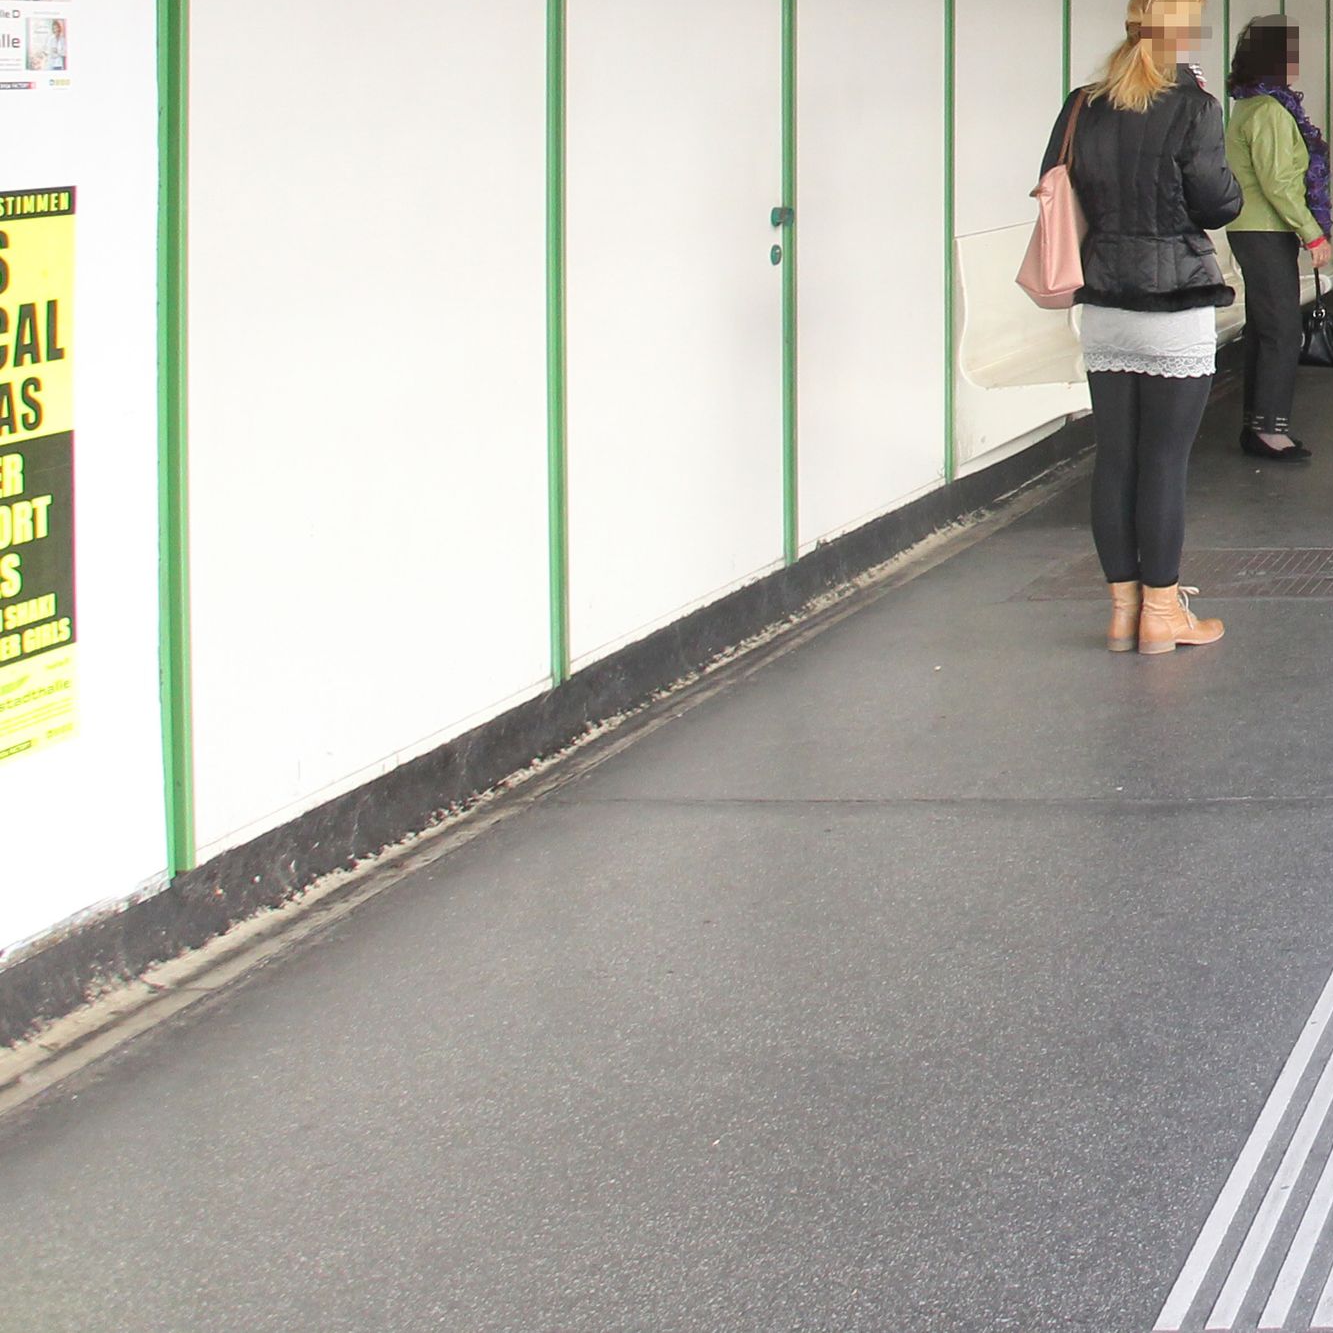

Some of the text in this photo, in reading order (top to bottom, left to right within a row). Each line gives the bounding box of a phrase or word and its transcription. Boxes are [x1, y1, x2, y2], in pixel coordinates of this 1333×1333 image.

[0, 34, 21, 49] lle
[0, 192, 69, 216] STIMMEN
[0, 453, 24, 499] R
